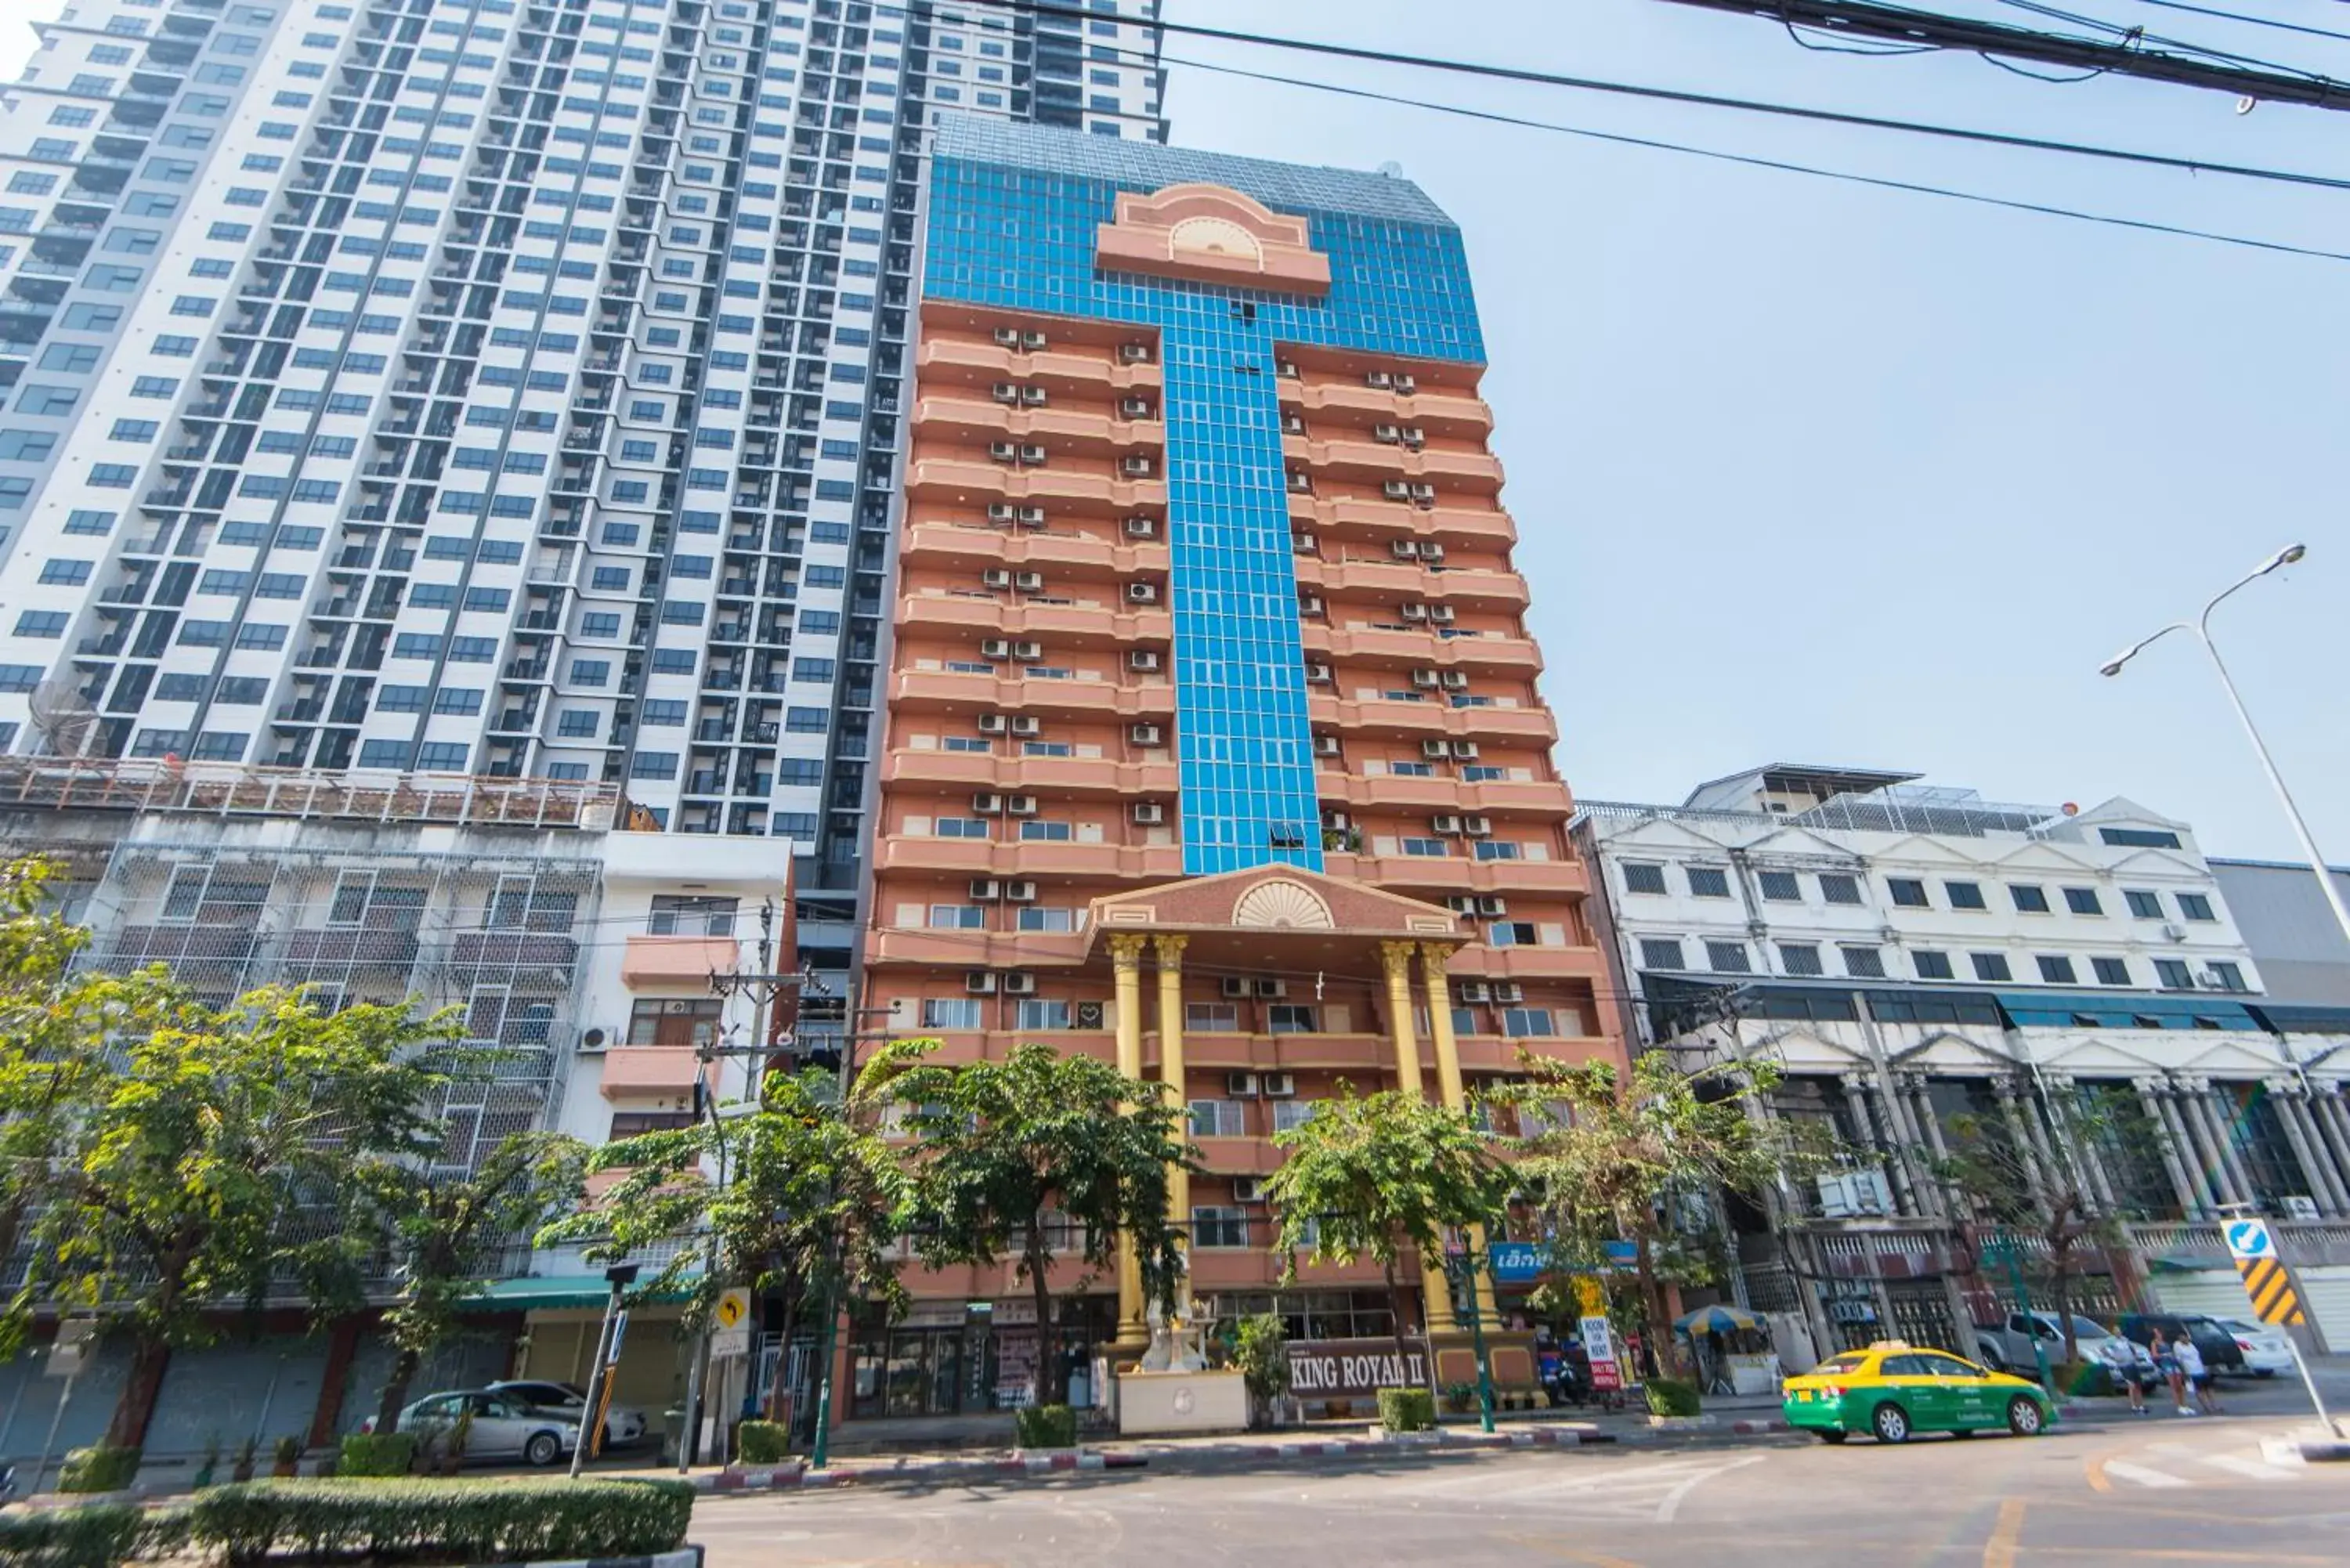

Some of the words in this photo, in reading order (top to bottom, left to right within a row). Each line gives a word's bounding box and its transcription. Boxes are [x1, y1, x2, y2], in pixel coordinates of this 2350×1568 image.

[1290, 1357, 1338, 1389] KING
[1342, 1354, 1405, 1386] ROYAL
[1407, 1353, 1424, 1384] II
